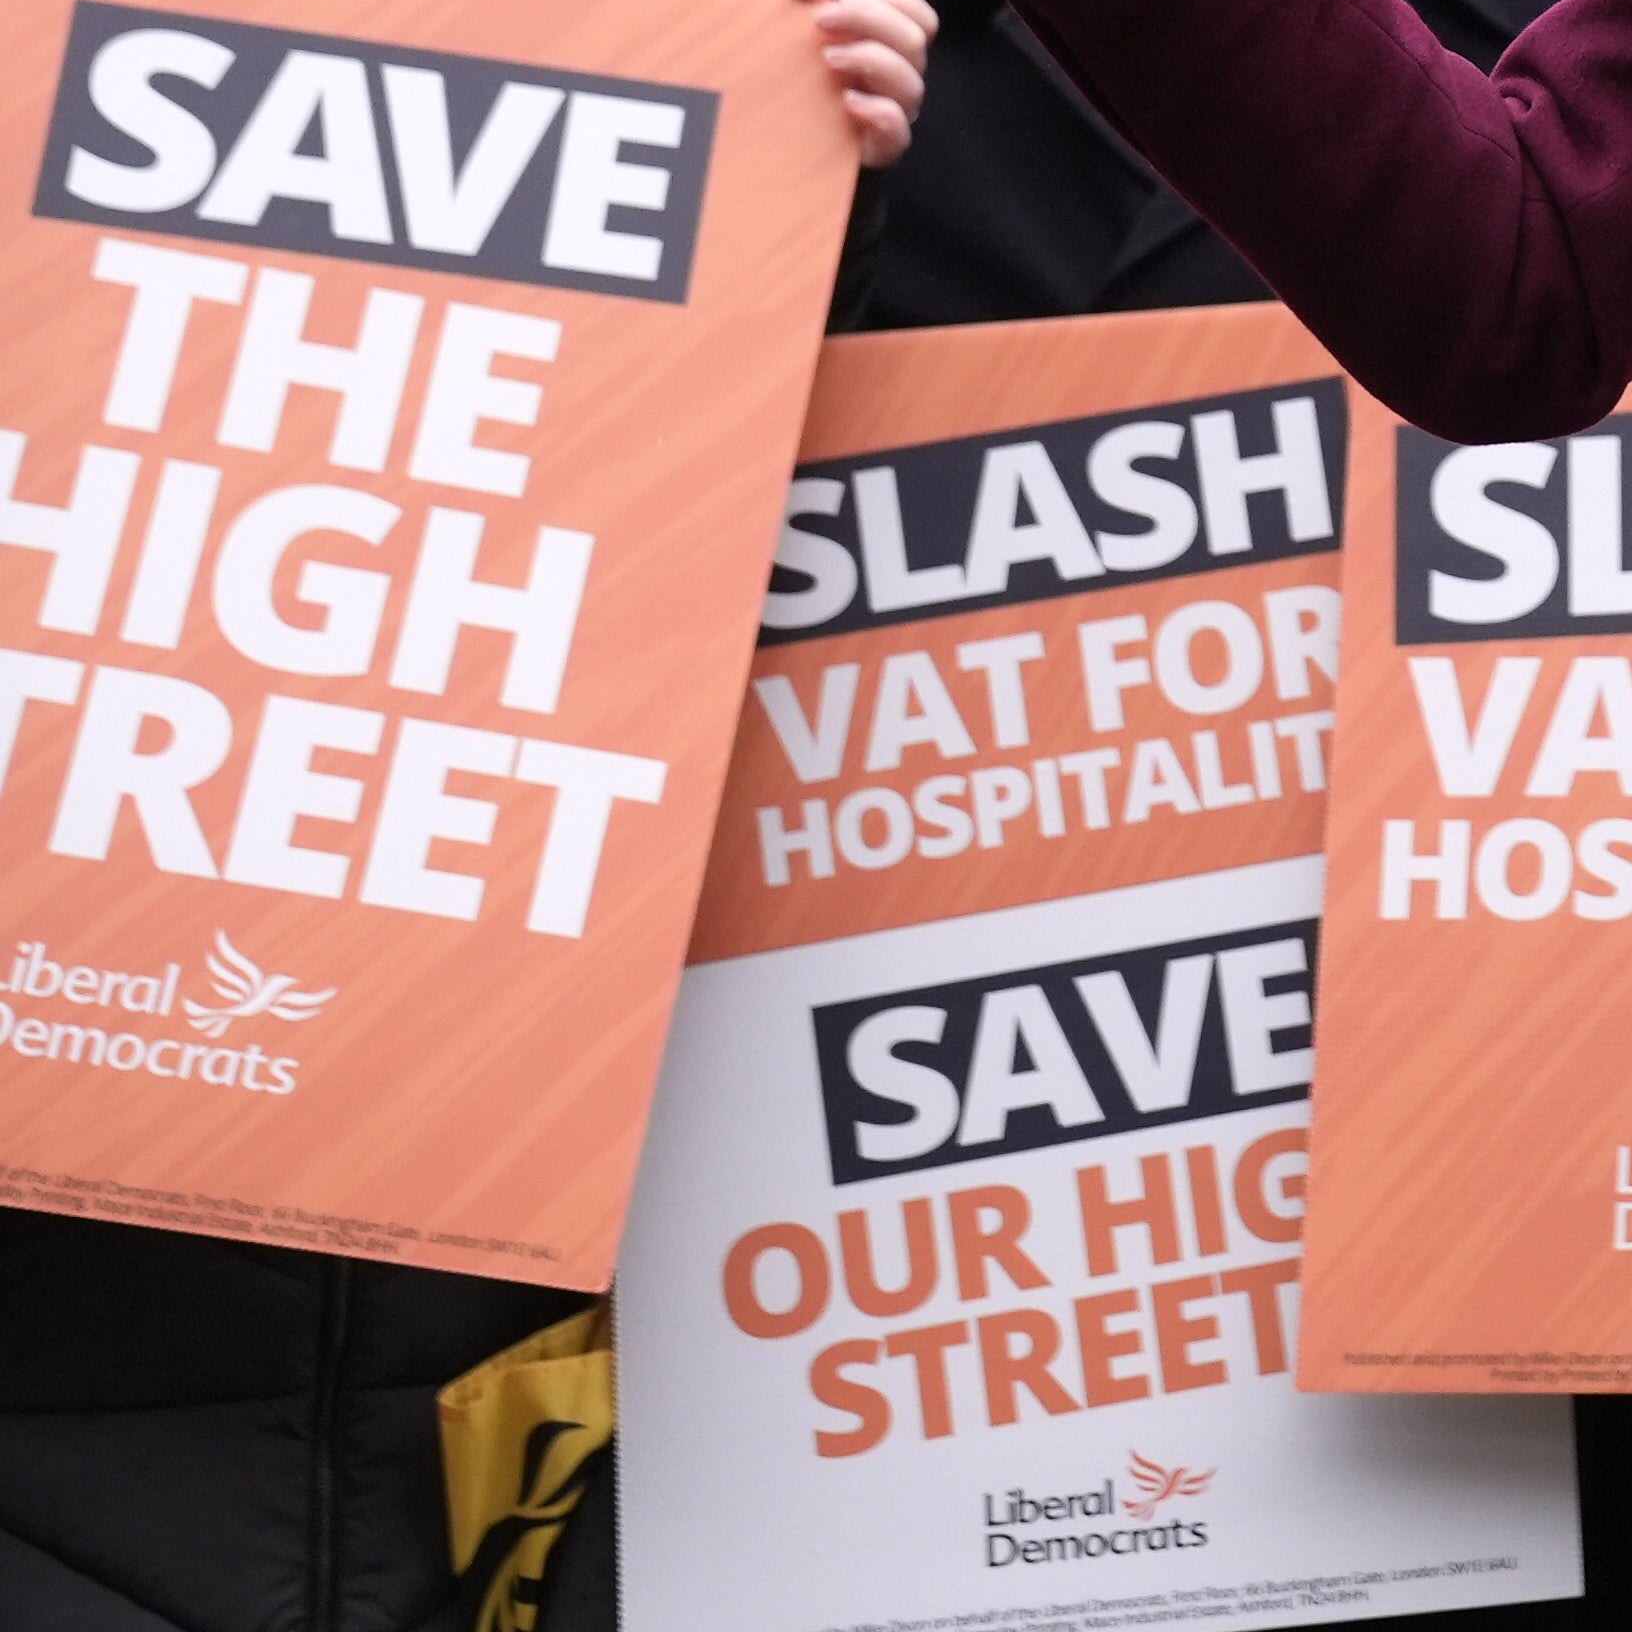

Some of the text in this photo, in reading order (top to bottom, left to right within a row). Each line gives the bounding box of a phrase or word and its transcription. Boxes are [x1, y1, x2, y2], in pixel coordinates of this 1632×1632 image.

[63, 28, 686, 282] SAVE
[91, 238, 563, 499] THE
[0, 426, 596, 715] HIGH
[761, 395, 1334, 630] SLASH
[754, 583, 1340, 785] VAT FOR
[0, 941, 181, 1017] iberal
[846, 938, 1310, 1162] SAVE
[721, 1184, 1051, 1340] OUR
[985, 1478, 1115, 1526] Liberal
[986, 1519, 1209, 1567] Democrats
